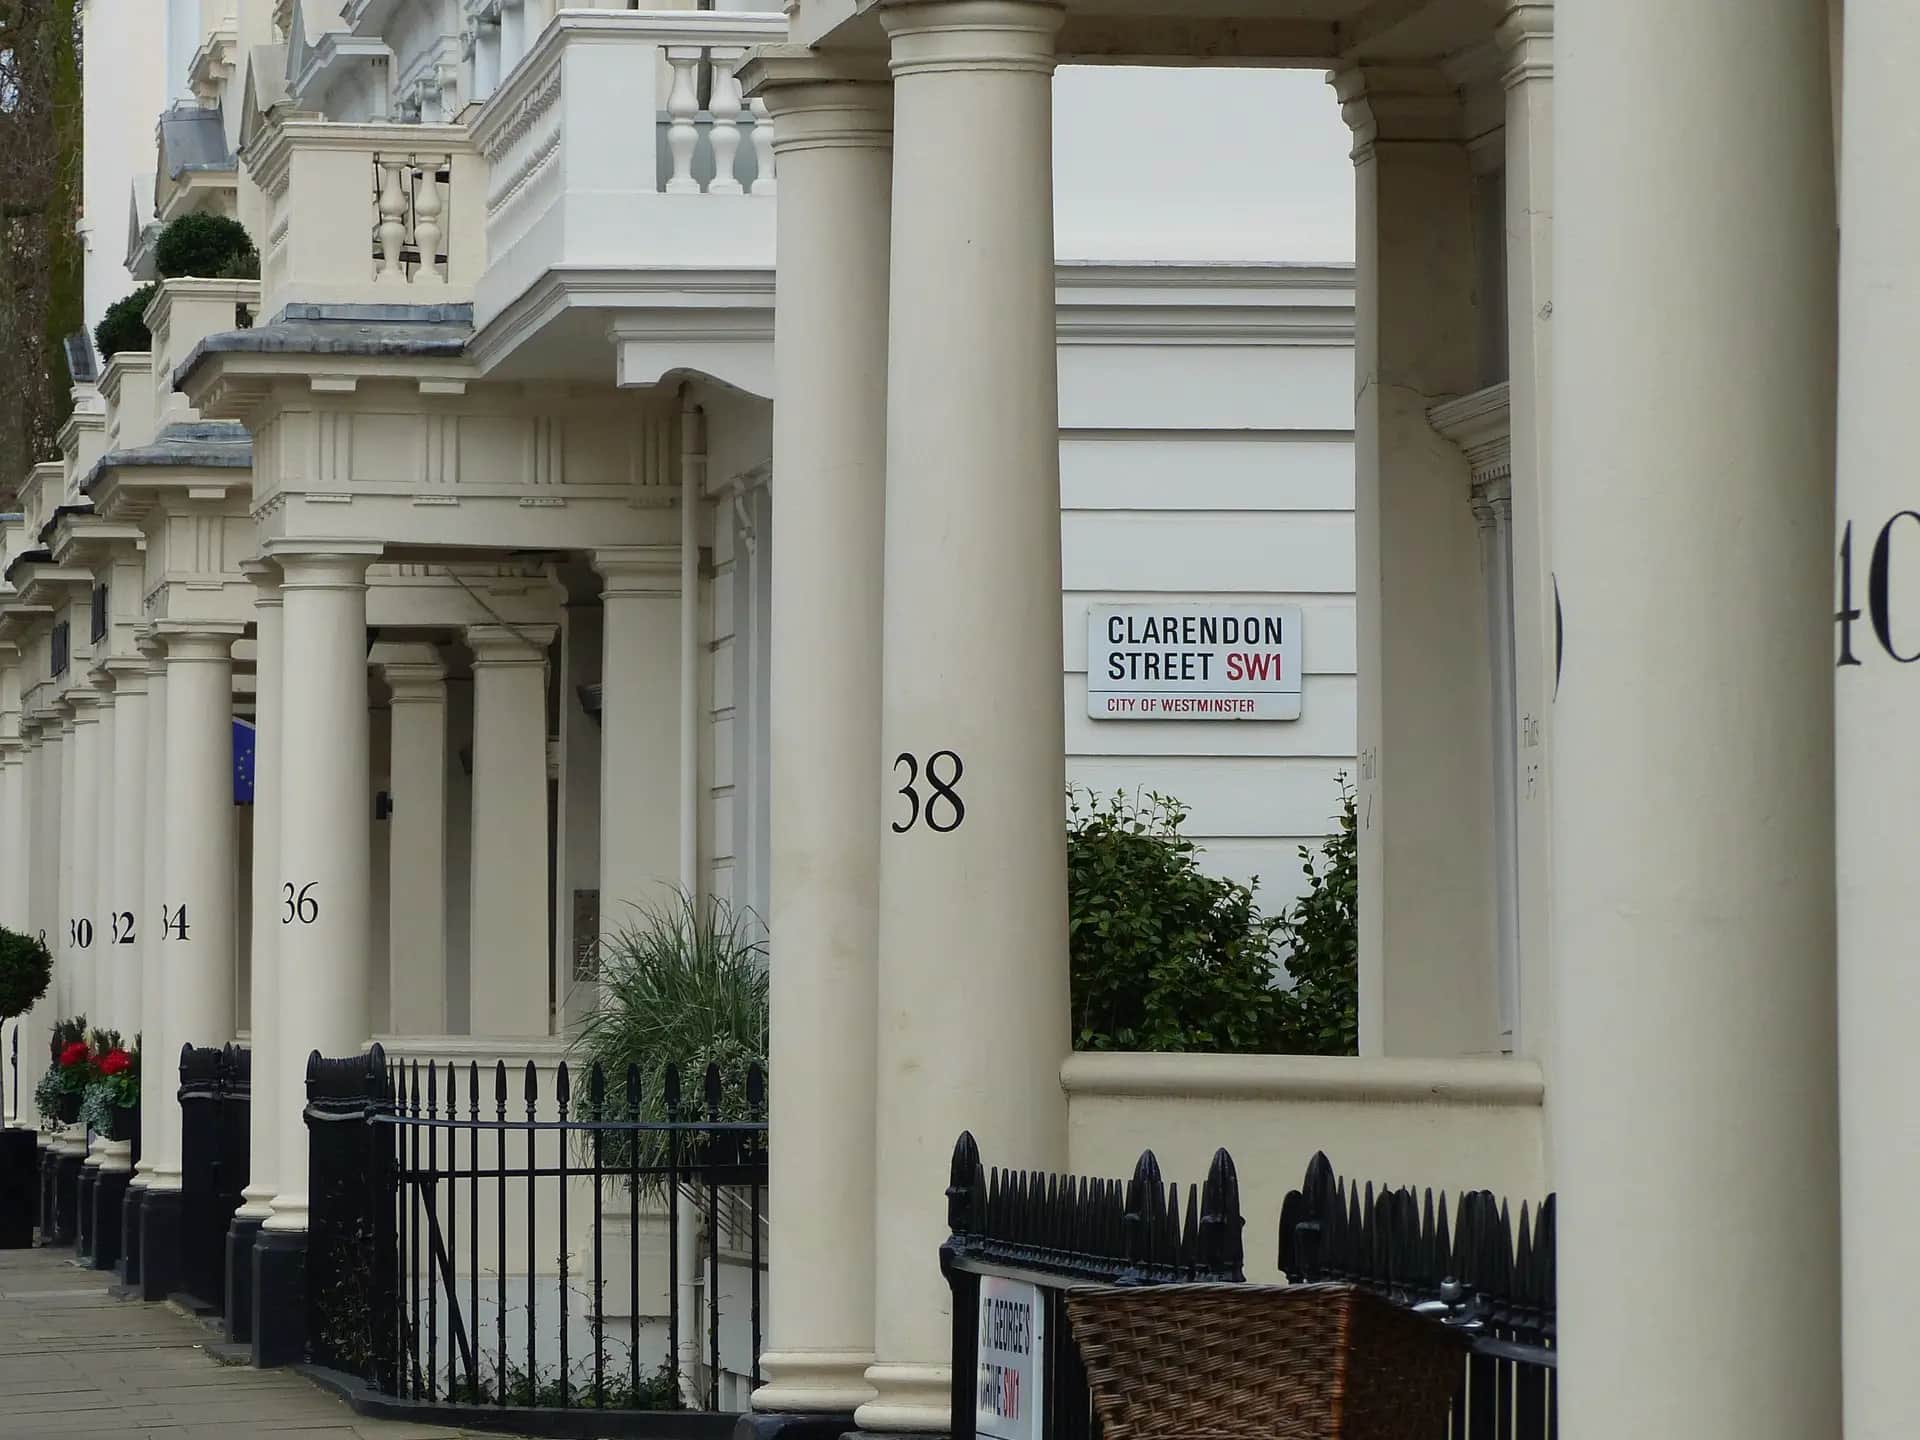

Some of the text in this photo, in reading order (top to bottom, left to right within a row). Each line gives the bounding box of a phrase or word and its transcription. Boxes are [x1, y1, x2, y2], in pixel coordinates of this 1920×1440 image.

[1107, 615, 1283, 645] CLARENDON
[1107, 651, 1282, 681] STREET SW1
[1107, 698, 1255, 713] CITY OF WESTMINSTER
[891, 750, 965, 833] 38
[282, 881, 319, 924] 36
[994, 1300, 1031, 1356] GEORGE'S
[980, 1362, 1020, 1420] DRIVE SW1
